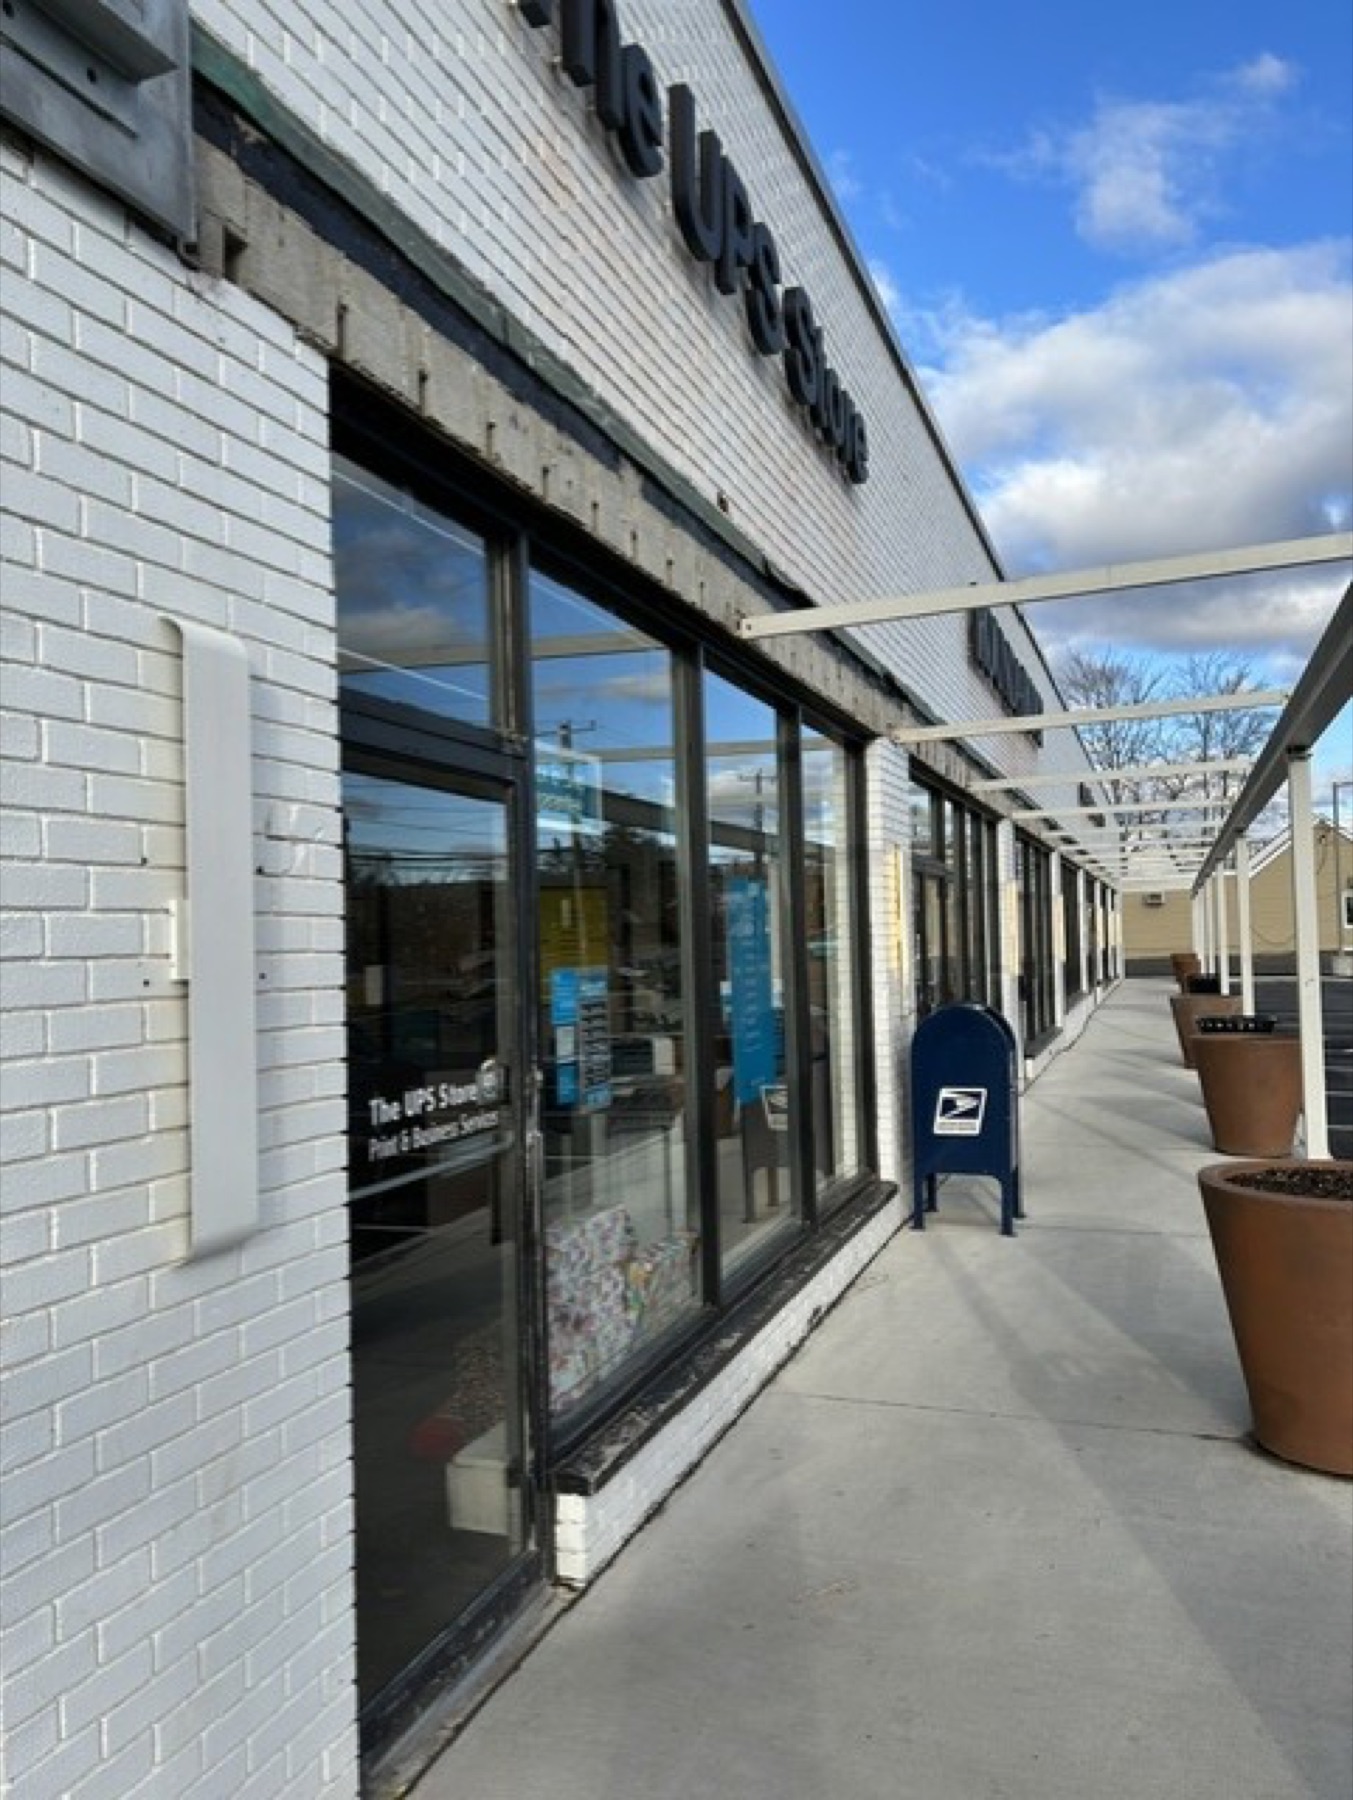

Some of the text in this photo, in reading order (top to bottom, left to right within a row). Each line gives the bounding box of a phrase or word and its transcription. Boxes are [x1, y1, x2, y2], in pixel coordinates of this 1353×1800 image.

[667, 82, 782, 356] UPS
[368, 1082, 478, 1126] The UPS Store
